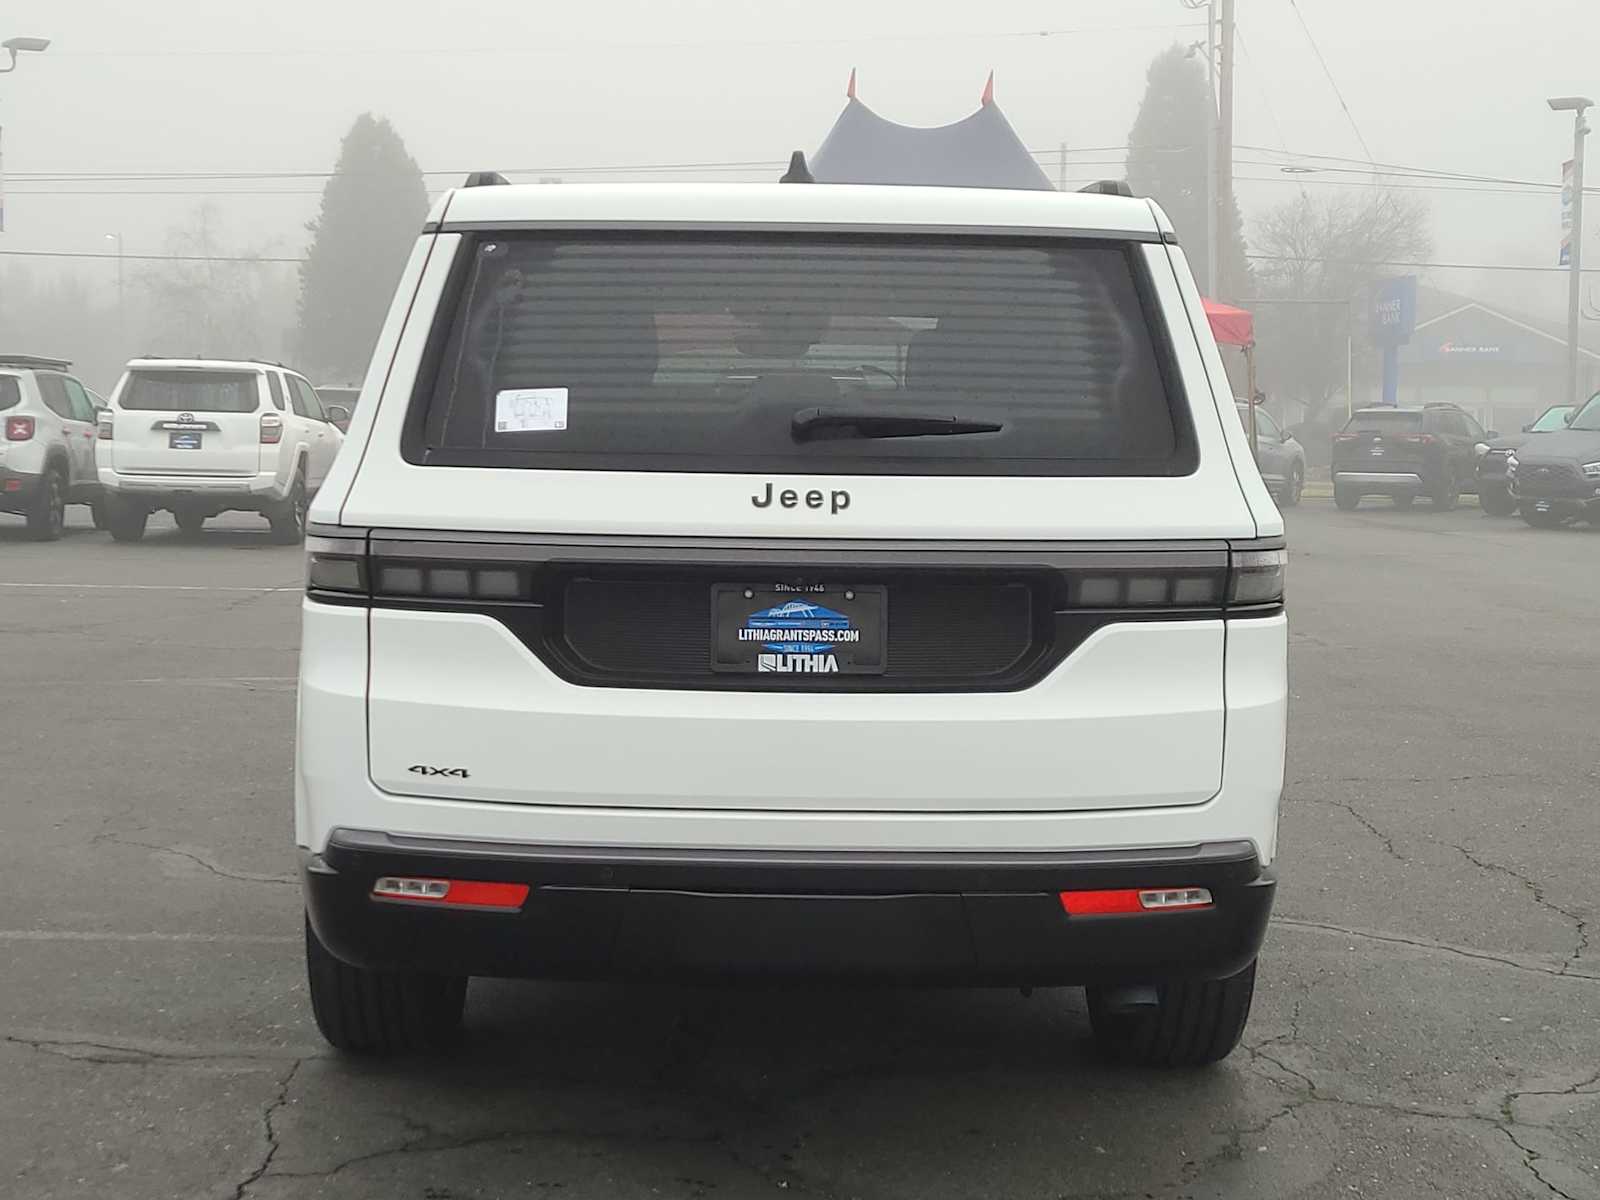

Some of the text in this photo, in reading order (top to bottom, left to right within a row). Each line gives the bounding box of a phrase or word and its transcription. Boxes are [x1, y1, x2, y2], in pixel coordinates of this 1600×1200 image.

[751, 482, 851, 515] Jeep
[738, 628, 860, 642] LITHIAGRANTSPASS.COM
[776, 654, 839, 672] LITHIA
